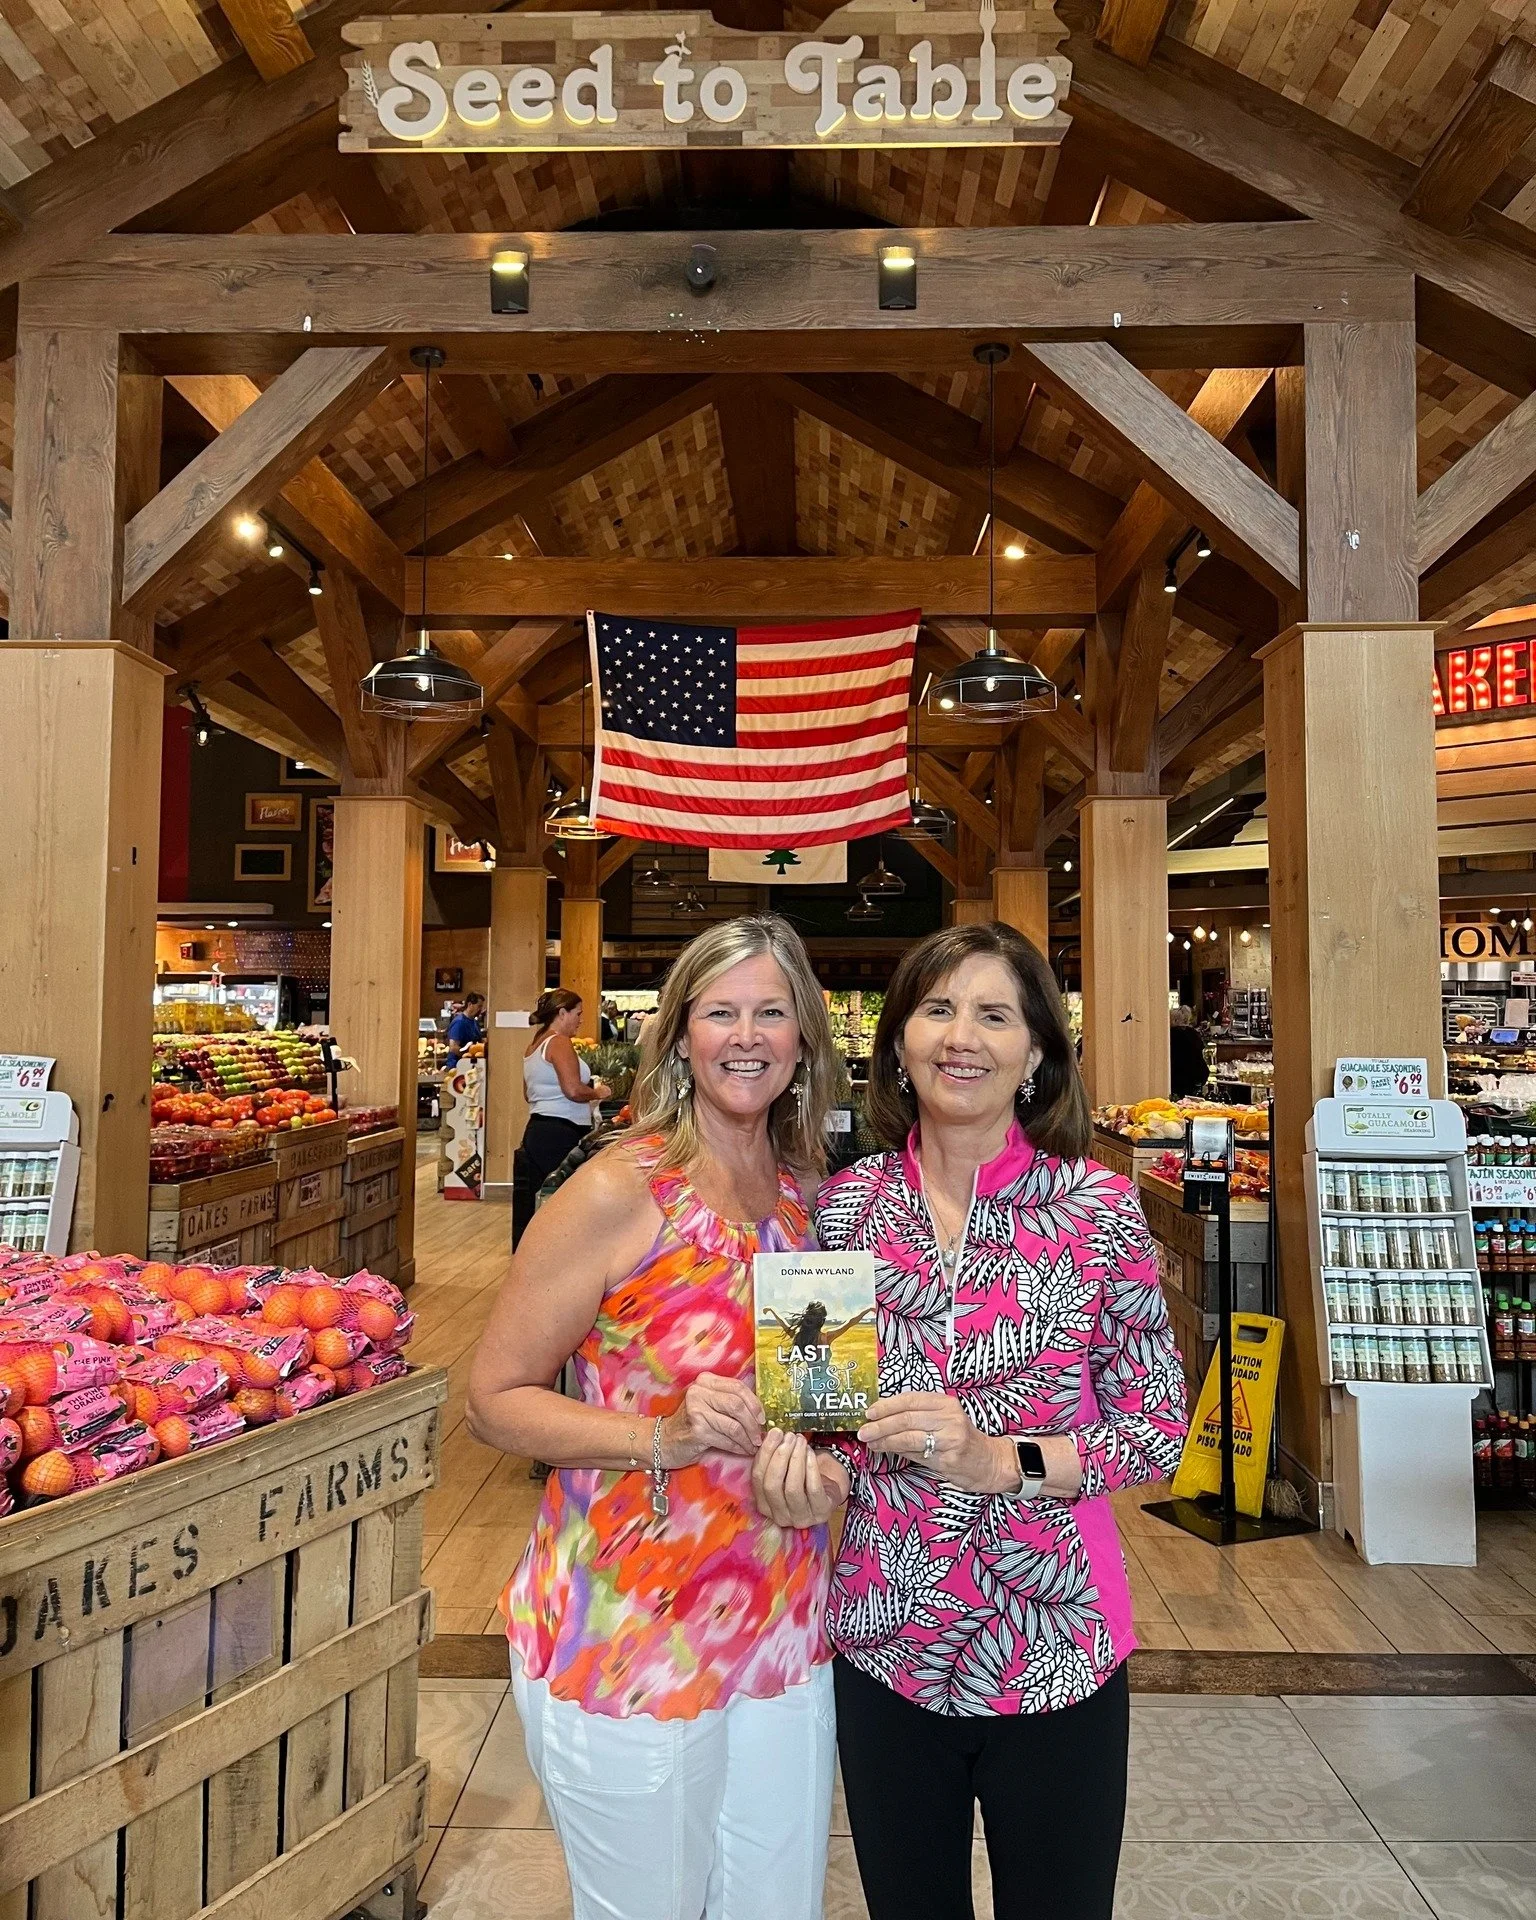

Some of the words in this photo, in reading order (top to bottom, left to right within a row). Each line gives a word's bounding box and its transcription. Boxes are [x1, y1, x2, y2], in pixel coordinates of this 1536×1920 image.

[377, 40, 618, 140] Seed
[653, 43, 747, 123] to
[785, 0, 1057, 137] Table
[1340, 1063, 1381, 1073] GUACAMOLE
[1382, 1064, 1422, 1074] SEASONING
[1368, 1120, 1428, 1128] GUACAMOLE
[460, 1158, 481, 1179] bare
[188, 1206, 228, 1237] OAKES
[781, 1268, 814, 1276] DONNA
[815, 1267, 855, 1276] WYLAND
[777, 1344, 830, 1362] LAST
[1231, 1354, 1262, 1368] AUTION
[786, 1361, 857, 1392] BEST
[67, 1395, 83, 1406] THE
[73, 1391, 107, 1410] ORANGE
[811, 1392, 868, 1410] YEAR
[1196, 1435, 1216, 1448] PISO
[1234, 1430, 1253, 1442] OOR
[258, 1436, 410, 1542] FARMS
